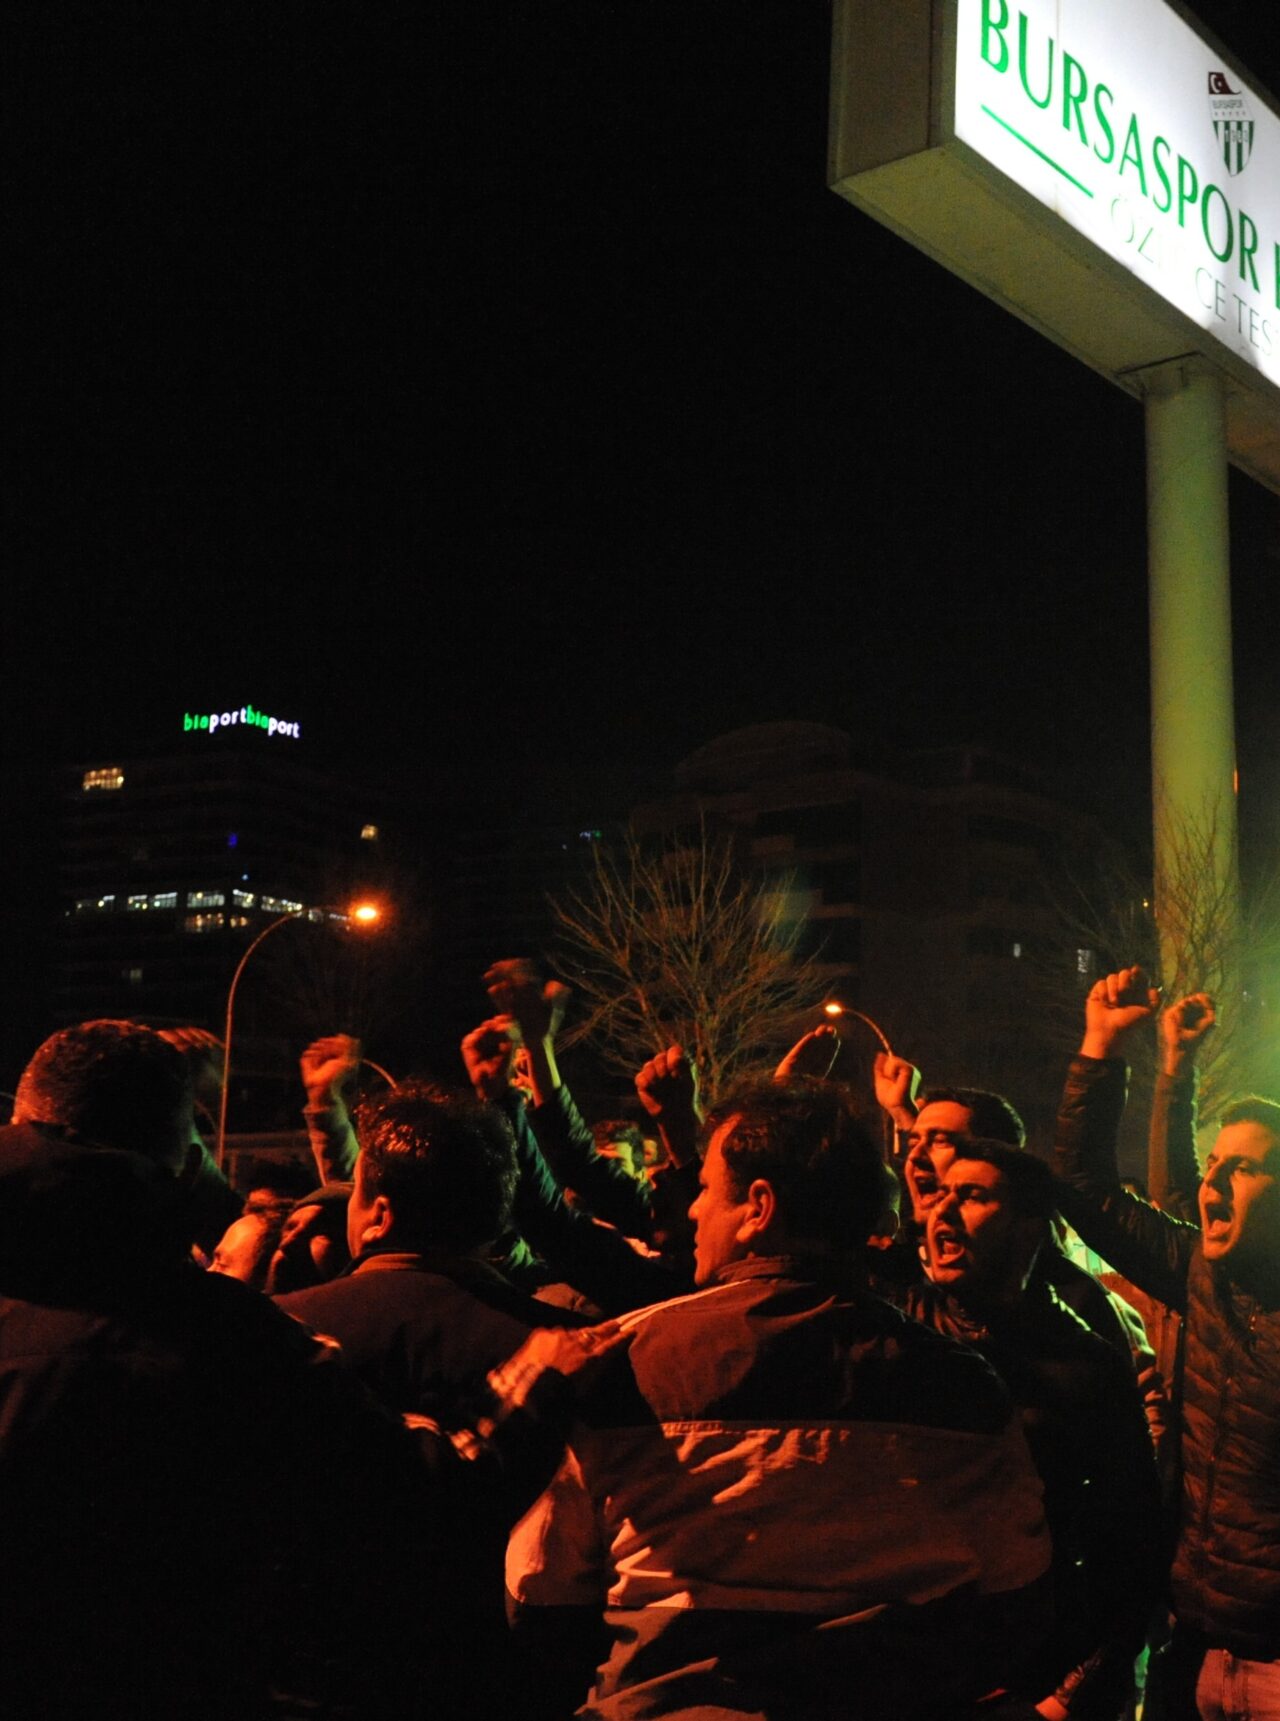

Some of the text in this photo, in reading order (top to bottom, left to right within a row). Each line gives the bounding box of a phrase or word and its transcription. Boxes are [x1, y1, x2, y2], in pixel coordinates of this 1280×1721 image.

[981, 0, 1260, 294] BURSASPOR
[184, 704, 300, 738] bioport bioport
